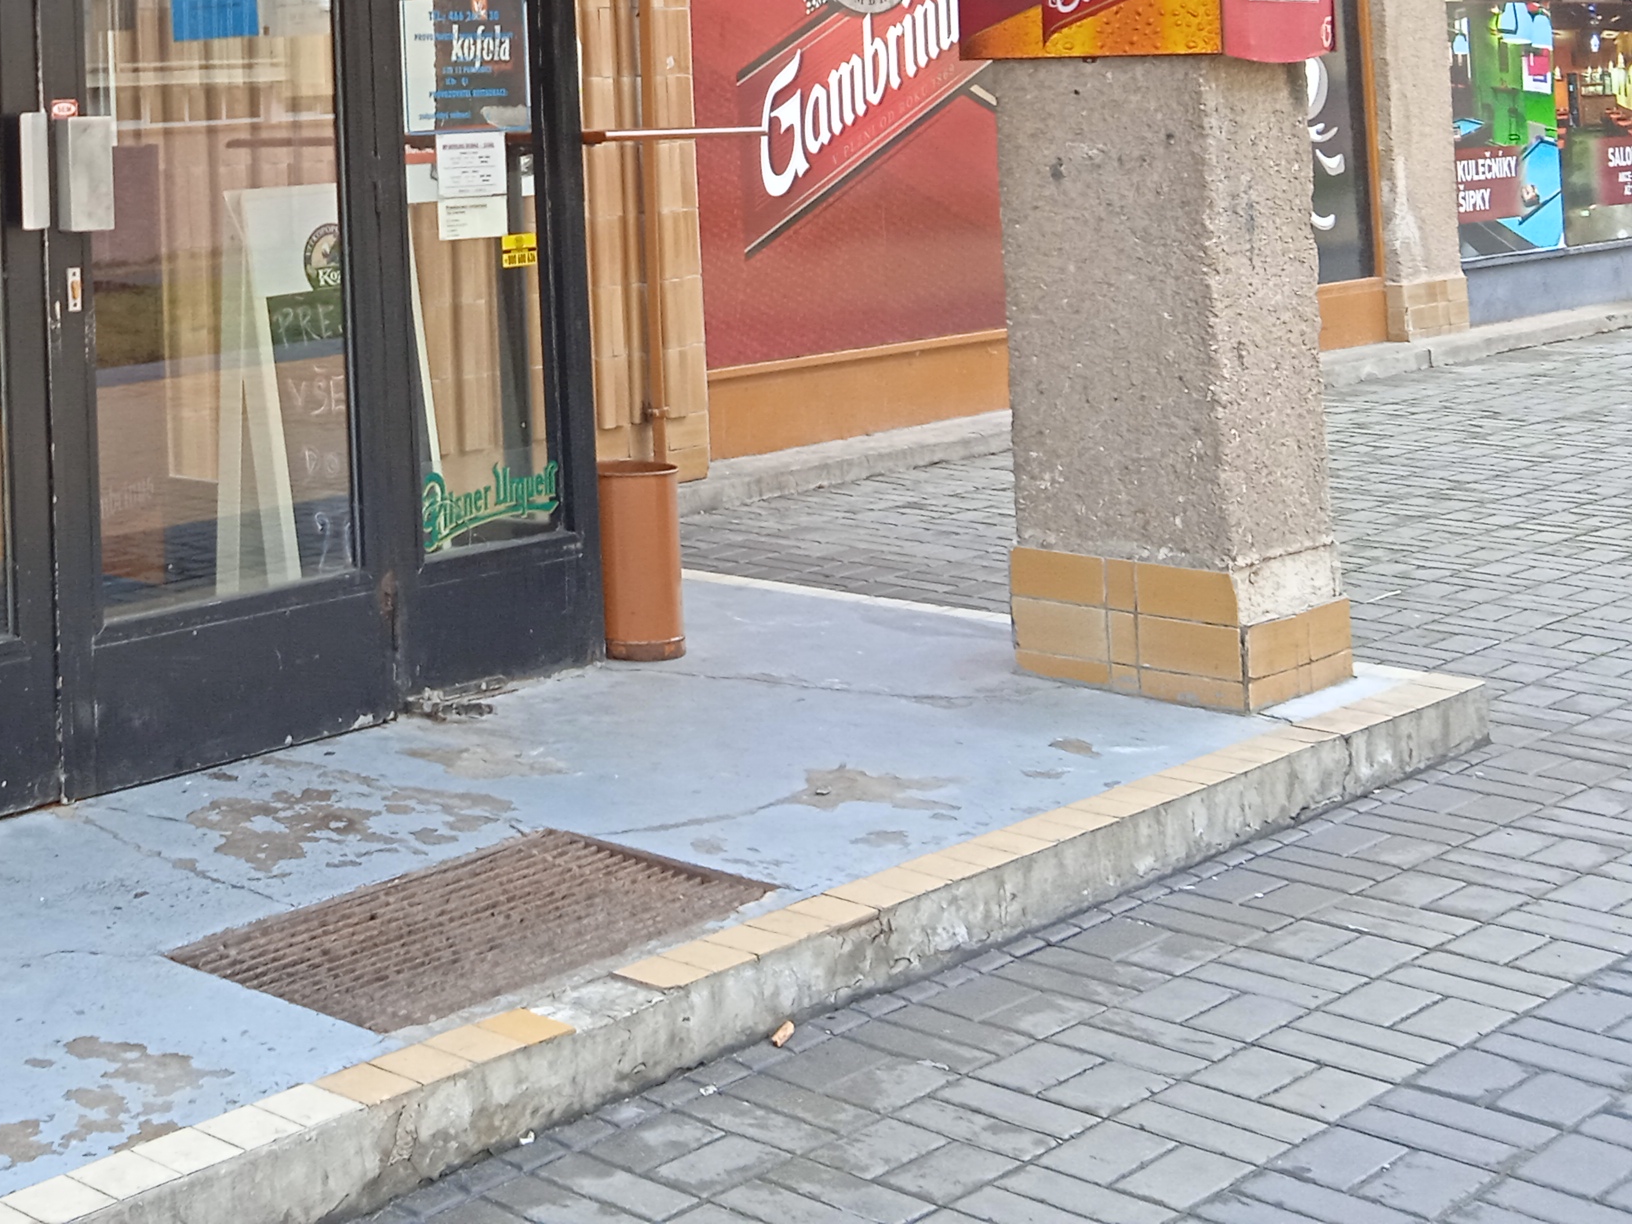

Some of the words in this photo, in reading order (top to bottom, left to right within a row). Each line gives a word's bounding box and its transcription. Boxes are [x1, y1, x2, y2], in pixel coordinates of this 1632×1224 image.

[451, 23, 511, 71] kofola
[1456, 150, 1518, 182] KULEČNÍKY
[1458, 184, 1492, 213] ŠIPKY
[423, 471, 491, 553] Pilsner
[493, 460, 559, 517] Urquell
